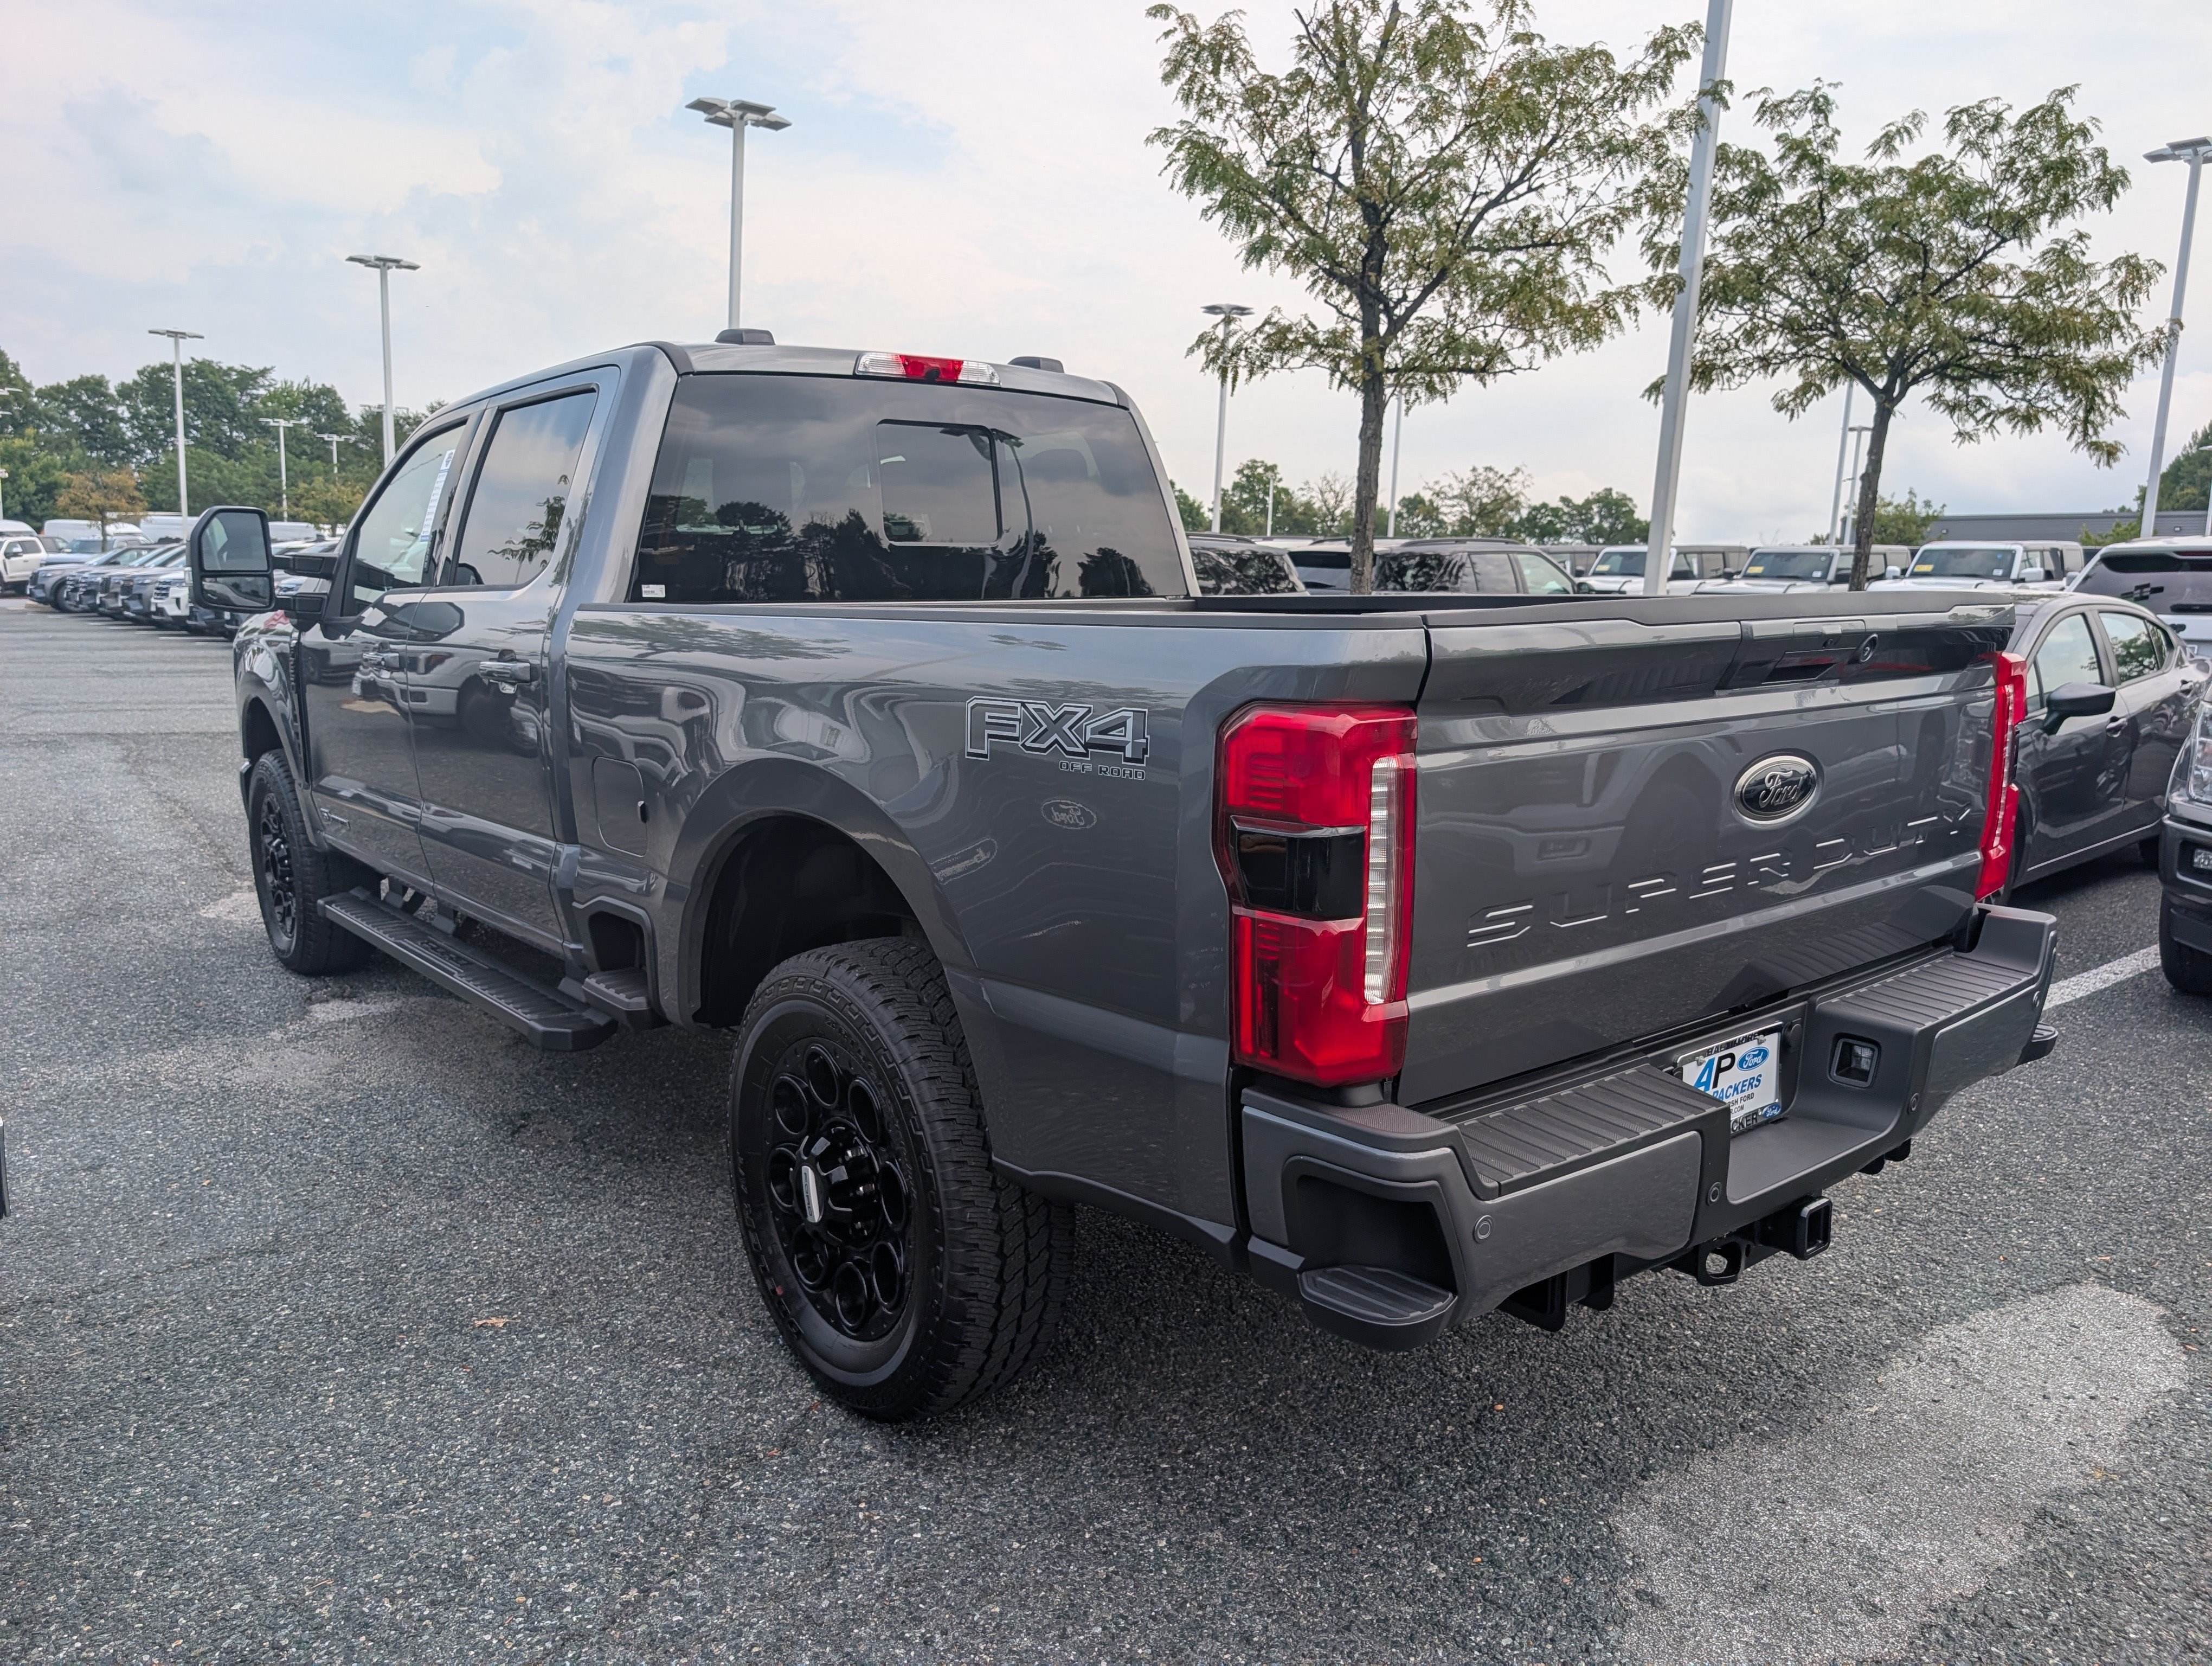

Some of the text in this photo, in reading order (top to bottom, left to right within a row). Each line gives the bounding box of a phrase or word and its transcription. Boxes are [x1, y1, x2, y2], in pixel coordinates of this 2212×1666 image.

[965, 695, 1150, 766] FX4
[1059, 760, 1146, 780] OFF ROAD
[1759, 770, 1804, 808] Ford
[1467, 808, 1972, 947] SUPER DUTY
[1706, 1033, 1758, 1057] BALTIMORE
[1740, 1092, 1754, 1105] FORD
[804, 1172, 813, 1216] FORD
